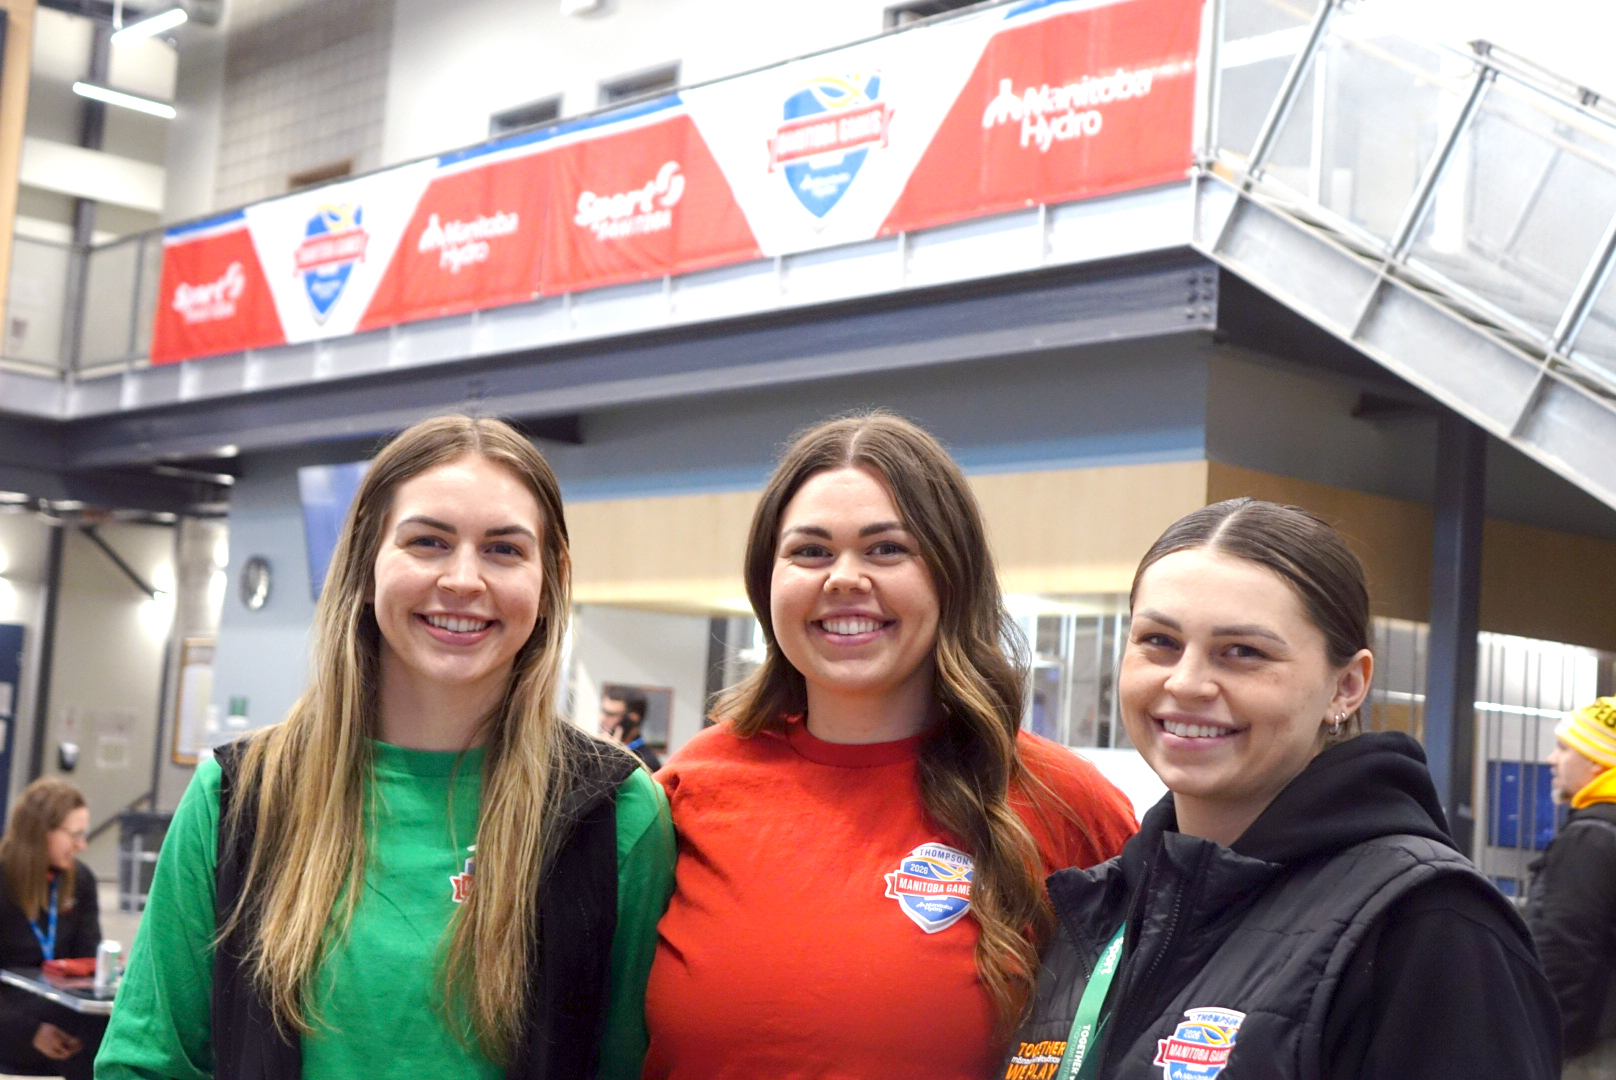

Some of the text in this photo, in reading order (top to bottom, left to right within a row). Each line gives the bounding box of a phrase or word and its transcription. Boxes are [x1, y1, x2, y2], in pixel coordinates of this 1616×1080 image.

[1022, 67, 1153, 117] Manitoba
[1020, 108, 1102, 153] Hydro
[444, 210, 519, 242] Manitoba
[439, 241, 490, 275] Hydro
[910, 863, 929, 875] 2026
[920, 848, 969, 866] THOMPSON
[898, 877, 971, 896] MANITOBA GAME
[926, 902, 953, 911] Manitoba
[1071, 1024, 1091, 1074] TOGETHER
[1168, 1043, 1210, 1062] MANITOBA
